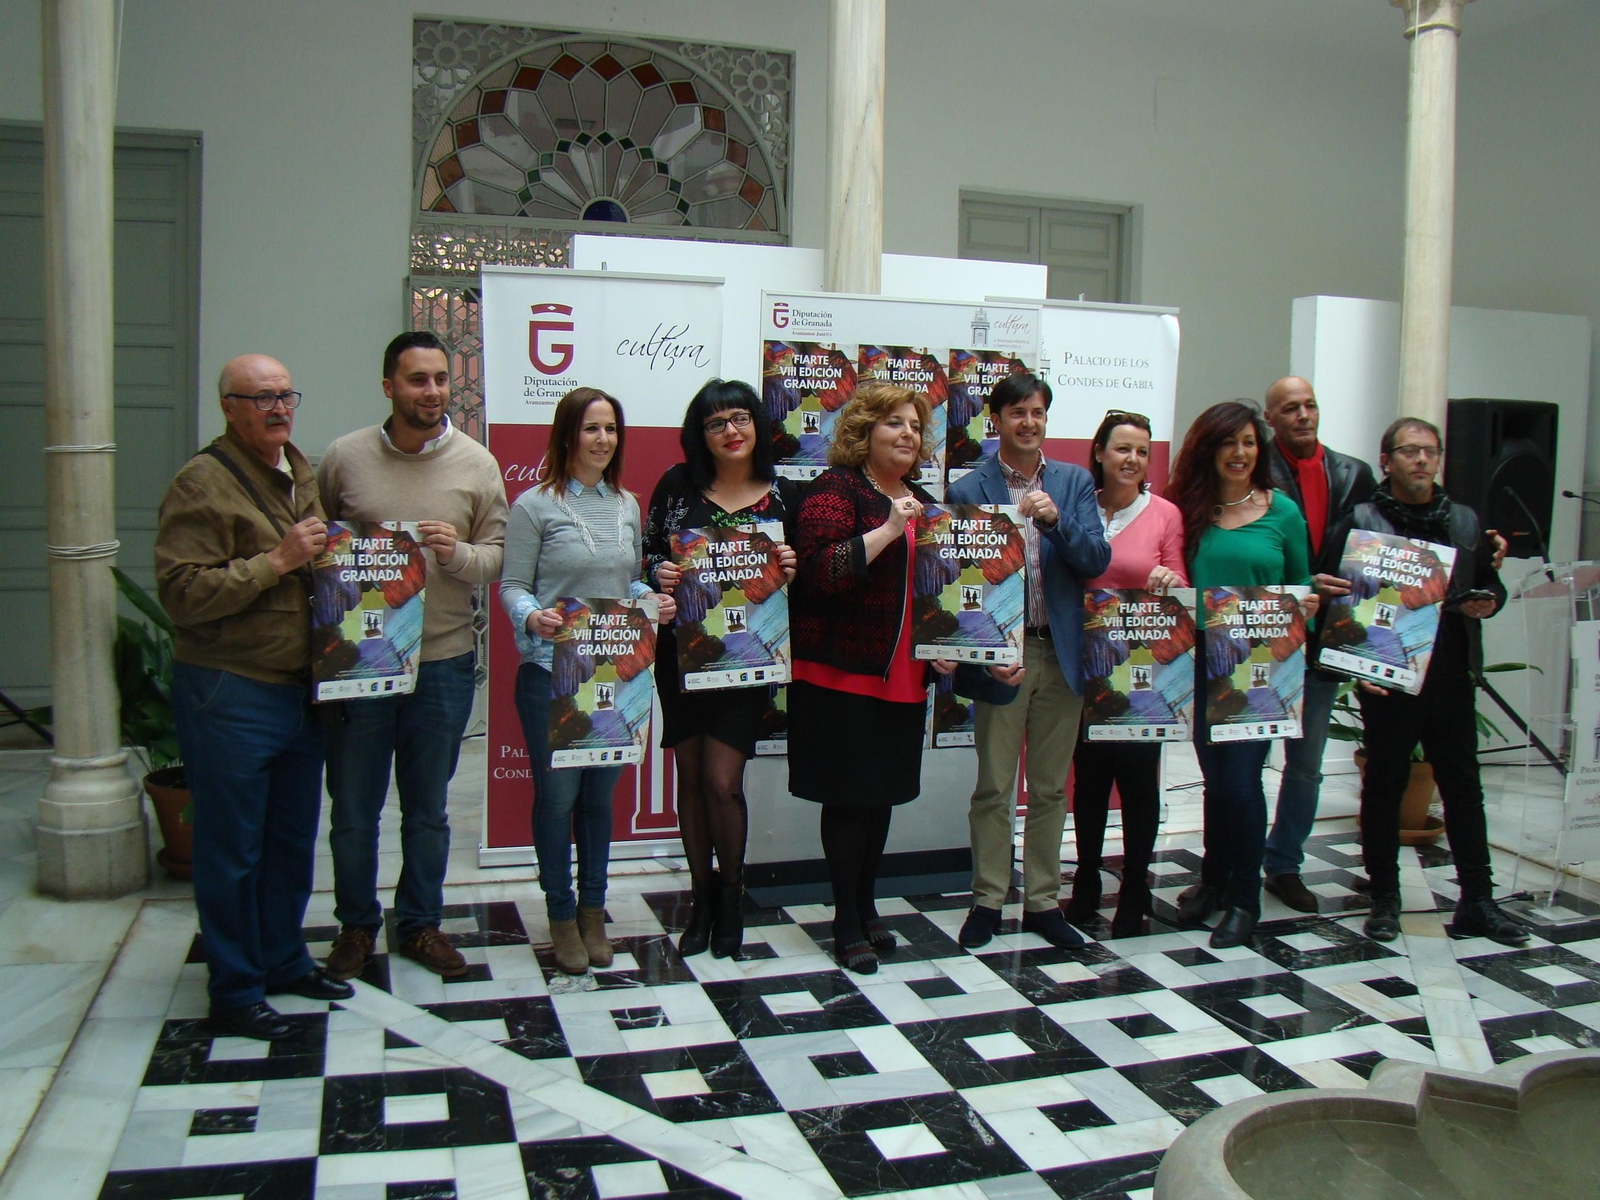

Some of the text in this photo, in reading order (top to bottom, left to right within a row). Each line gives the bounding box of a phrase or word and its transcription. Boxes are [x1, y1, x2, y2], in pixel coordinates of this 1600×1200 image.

[792, 309, 833, 319] Diputación
[791, 318, 833, 327] de Granada
[616, 322, 711, 371] cultura
[793, 354, 829, 365] FIARTE
[887, 359, 921, 369] FIARTE
[1064, 351, 1150, 368] PALACIO DE LOS
[780, 365, 842, 378] VIII EDICIÓN
[976, 362, 1010, 373] FIARTE
[524, 376, 578, 387] Diputación
[874, 369, 934, 382] VIII EDICIÓN
[963, 374, 980, 384] VIII
[1057, 373, 1154, 390] CONDES DE GABIA
[783, 378, 837, 390] GRANADA
[523, 387, 536, 397] de
[967, 386, 993, 396] GRAN
[951, 519, 992, 531] FIARTE
[351, 538, 394, 550] FIARTE
[934, 531, 1008, 545] VIII EDICIÓN
[708, 540, 751, 554] FIARTE
[334, 550, 409, 566] VIII EDICIÓN
[939, 548, 1003, 559] GRANADA
[1378, 545, 1420, 563] FIARTE
[692, 551, 767, 570] VIII EDICIÓN
[1361, 553, 1432, 578] VIII EDICIÓN
[340, 569, 404, 582] GRANADA
[698, 568, 764, 584] GRANADA
[1362, 566, 1423, 589] GRANADA
[1119, 602, 1161, 614] FIARTE
[1238, 600, 1280, 611] FIARTE
[588, 614, 628, 626] FIARTE
[1102, 612, 1177, 627] VIII EDICIÓN
[1223, 611, 1293, 625] VIII EDICIÓN
[573, 626, 641, 641] VIII EDICIÓN
[1108, 629, 1172, 641] GRANADA
[1229, 627, 1289, 639] GRANADA
[577, 644, 635, 656] GRANADA
[493, 767, 533, 779] COND
